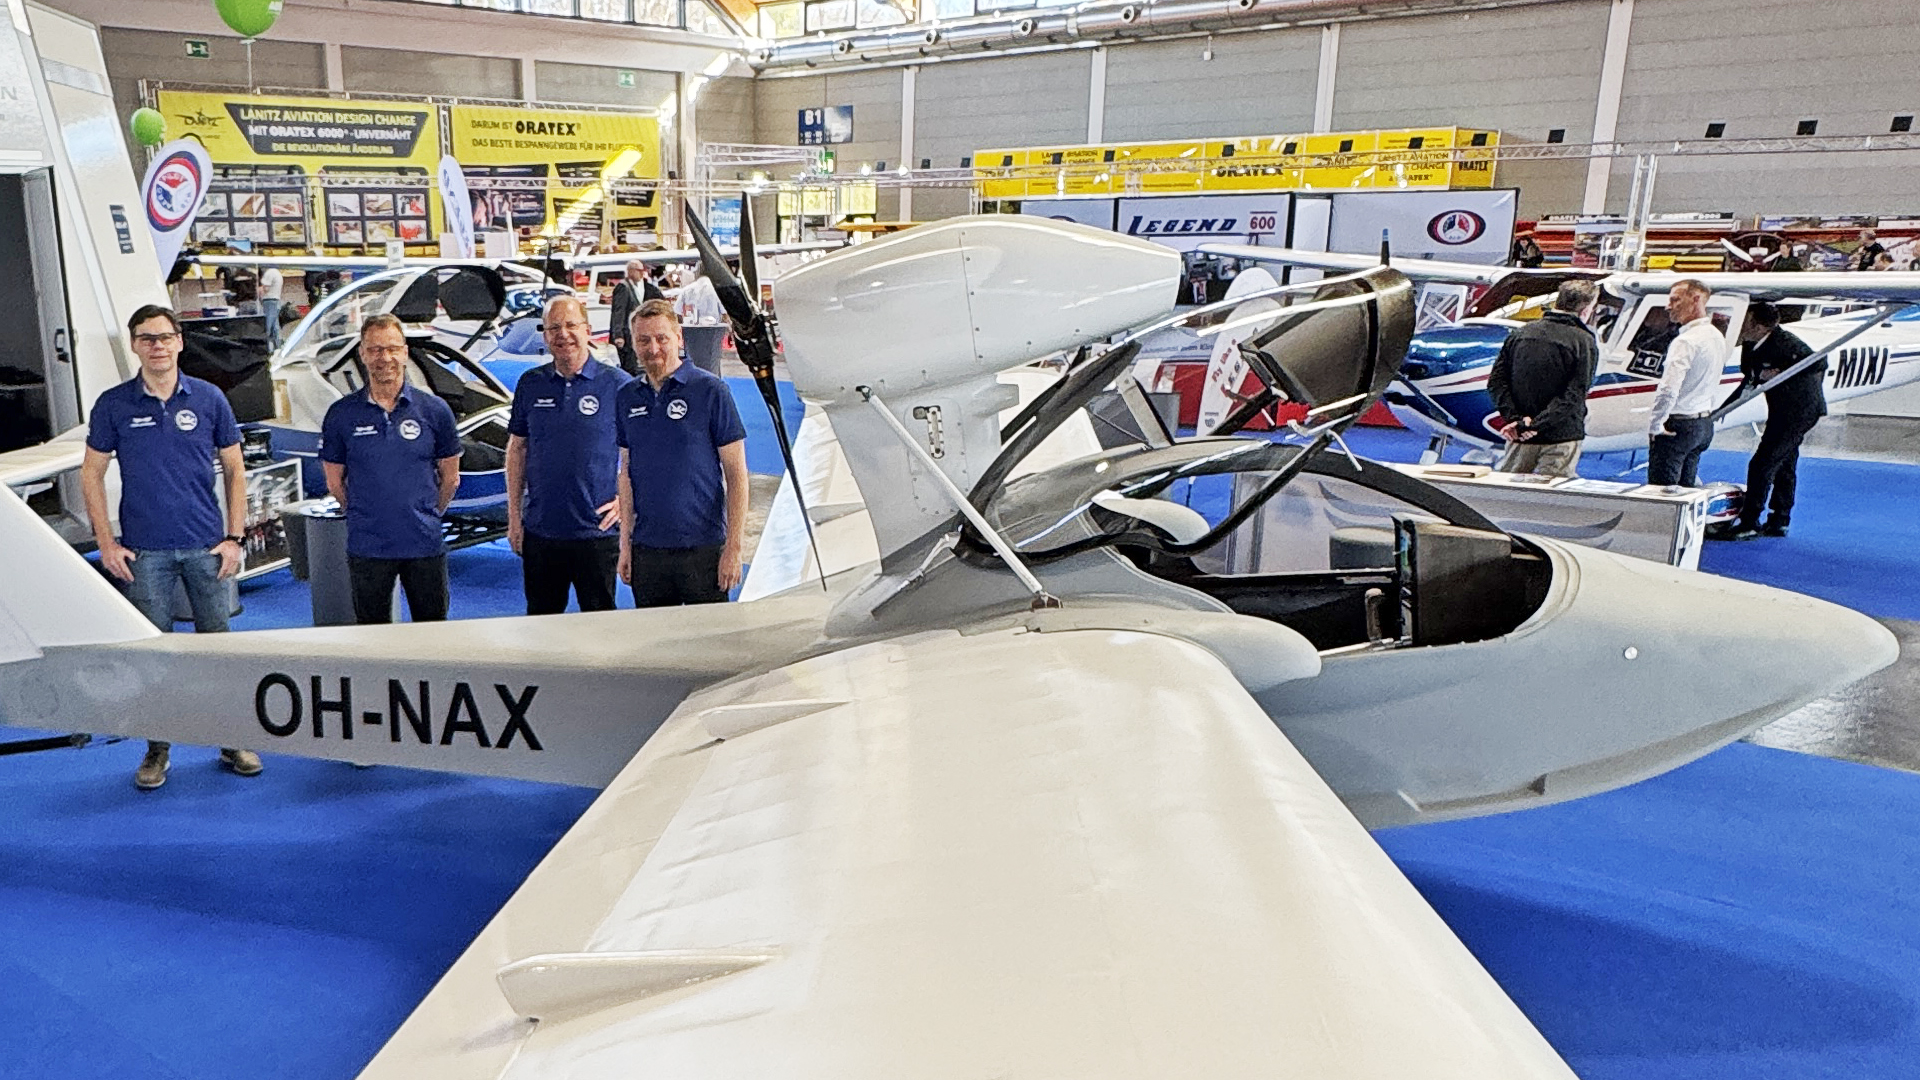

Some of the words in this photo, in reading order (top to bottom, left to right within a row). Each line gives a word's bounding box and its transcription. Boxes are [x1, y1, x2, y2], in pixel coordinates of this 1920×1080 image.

[240, 108, 281, 121] LANITZ
[284, 110, 334, 124] AVIATION
[335, 112, 372, 125] DESIGN
[374, 113, 417, 126] CHANGE
[471, 119, 500, 130] DARUM
[502, 121, 513, 130] IST
[247, 124, 268, 136] MIT
[269, 126, 316, 139] ORATEX
[472, 138, 488, 148] DAS
[490, 139, 513, 149] BESTE
[579, 140, 594, 151] FÜR
[1128, 215, 1238, 236] LEGEND
[1249, 216, 1276, 230] 600
[255, 671, 544, 751] OH-NAX
